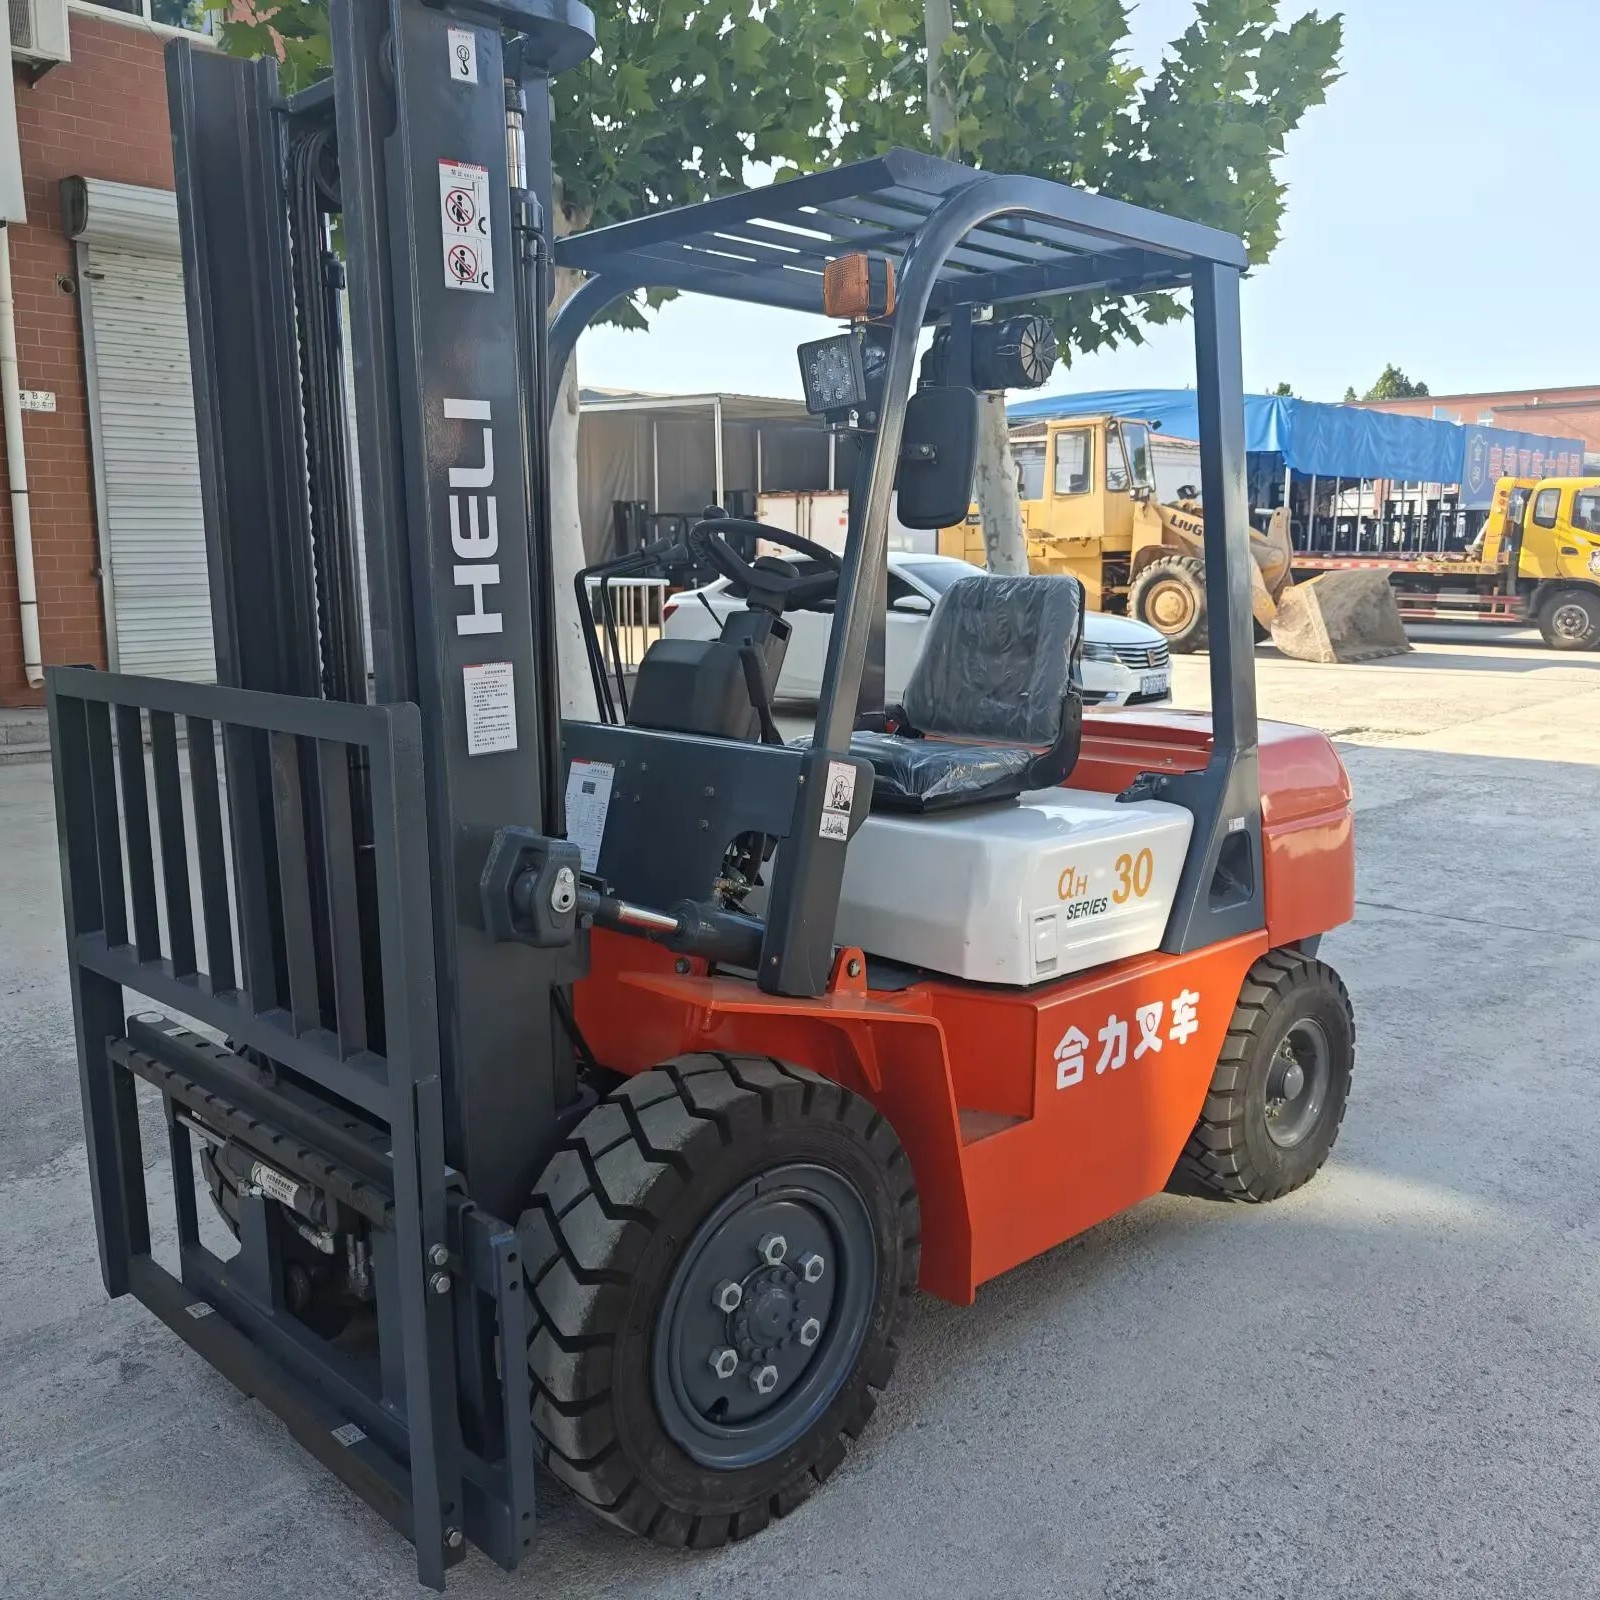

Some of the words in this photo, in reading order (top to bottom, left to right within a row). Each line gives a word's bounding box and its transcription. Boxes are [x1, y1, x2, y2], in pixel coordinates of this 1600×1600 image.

[443, 398, 503, 636] HELI
[1066, 897, 1108, 920] SERIES
[1112, 847, 1153, 904] 30
[1053, 989, 1200, 1090] 合力叉车
